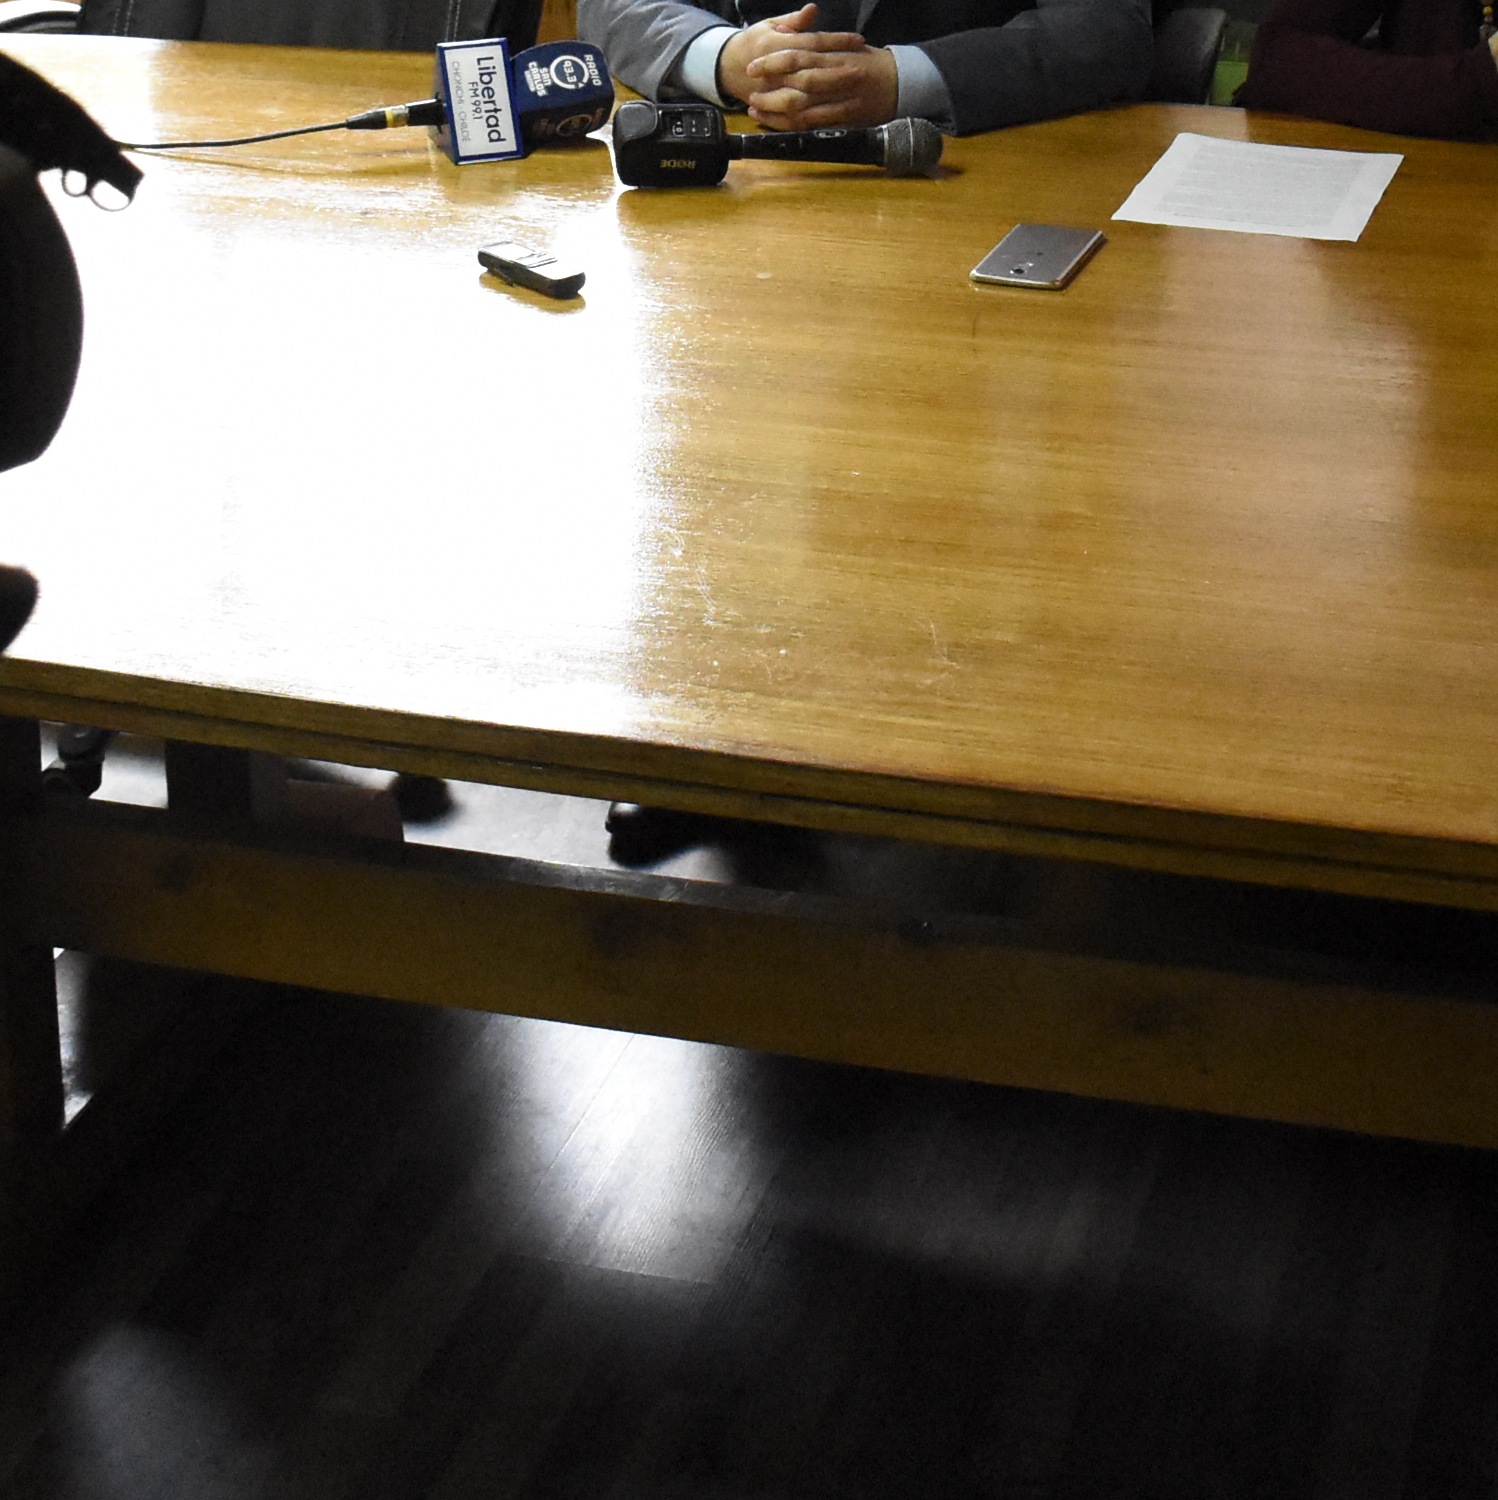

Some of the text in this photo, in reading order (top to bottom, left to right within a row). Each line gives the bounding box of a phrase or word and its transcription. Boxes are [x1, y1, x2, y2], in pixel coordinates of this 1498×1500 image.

[451, 60, 466, 106] CHONCHI
[528, 60, 549, 97] CARLOS
[539, 67, 552, 86] SAN
[562, 60, 578, 83] 93.3
[584, 53, 602, 87] RADIO
[468, 81, 484, 120] FM 99.1
[476, 56, 507, 143] Libertad
